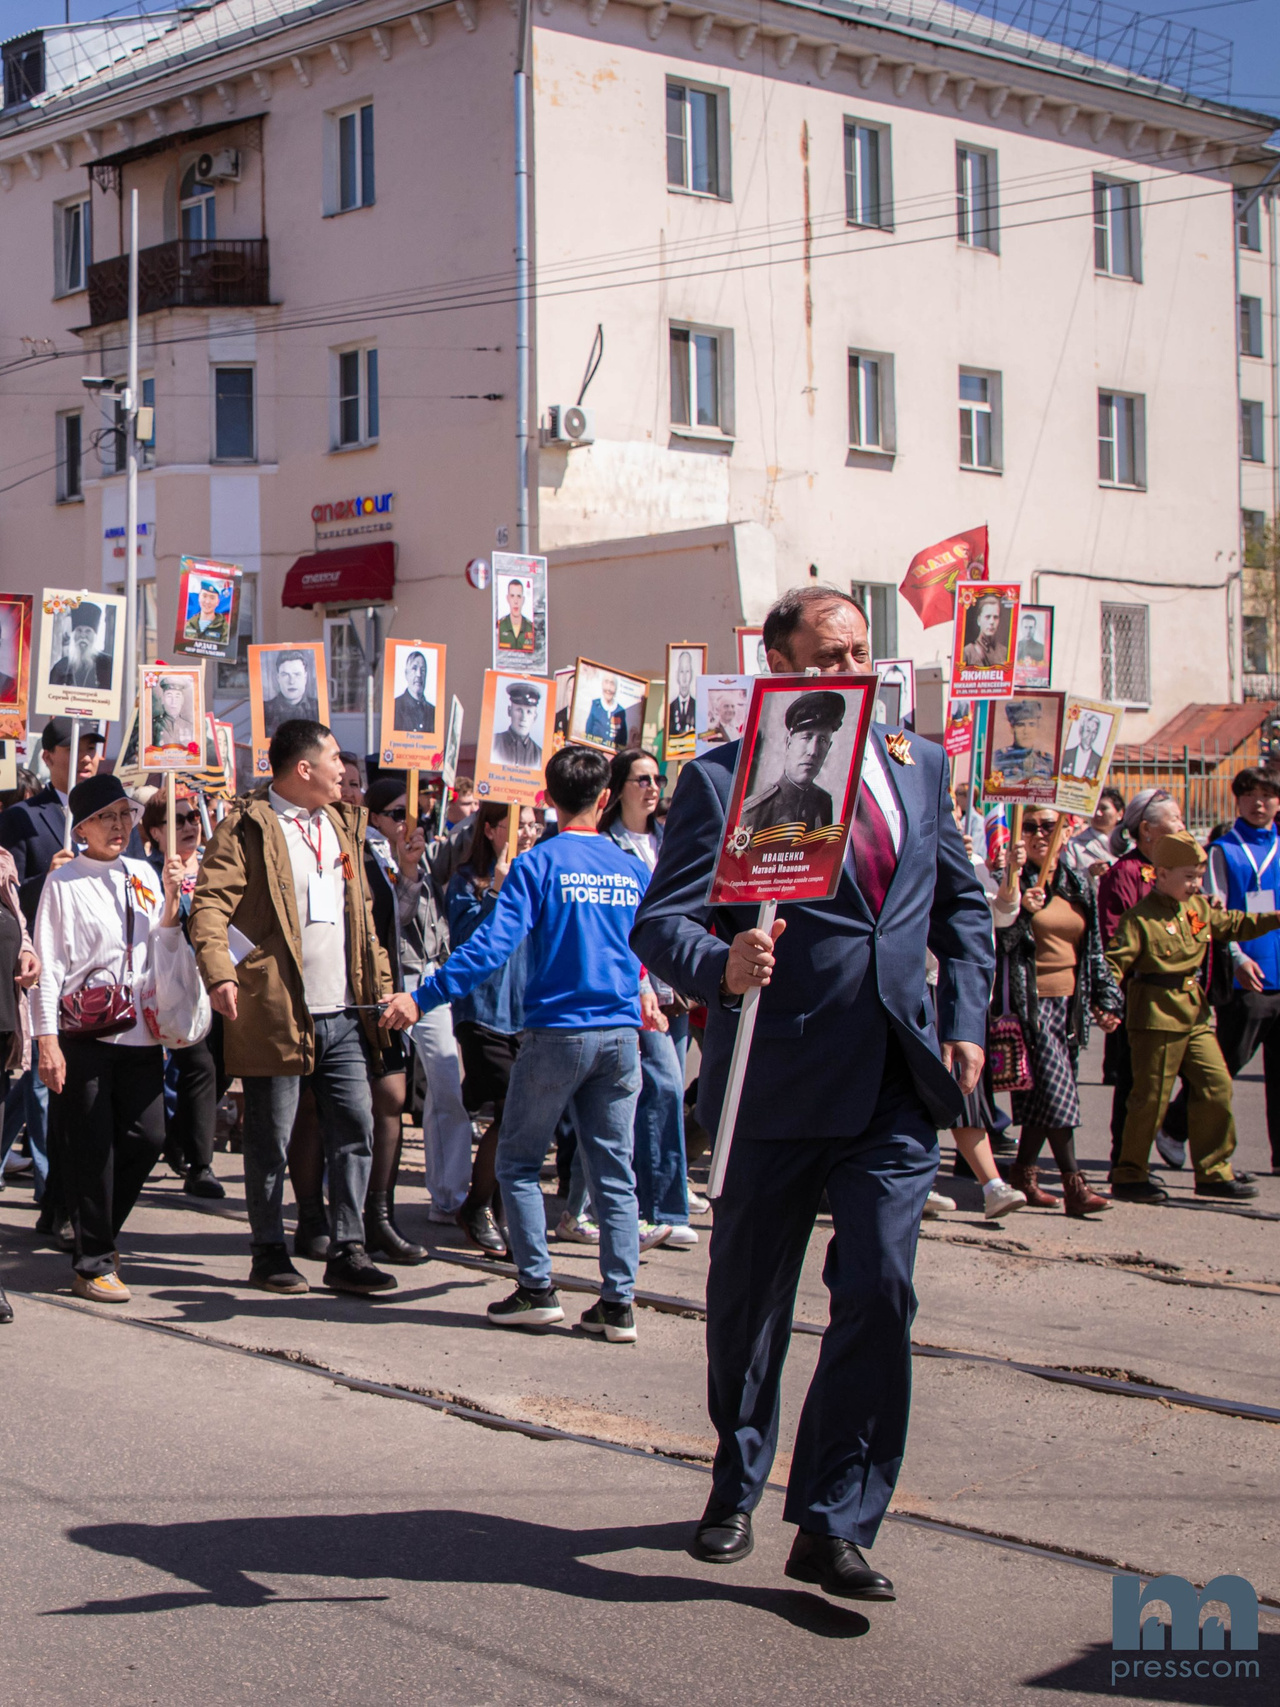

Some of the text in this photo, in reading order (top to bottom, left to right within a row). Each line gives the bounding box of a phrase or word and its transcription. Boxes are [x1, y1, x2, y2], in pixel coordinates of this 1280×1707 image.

[311, 493, 393, 523] anextour
[961, 670, 1004, 681] ЯКИМЕЦ
[761, 851, 805, 863] ИВАЩЕНКО
[751, 864, 810, 875] Матвей Иванович
[560, 872, 639, 889] ВОЛОНТЁРЫ
[562, 886, 639, 907] ПОБЕДЫ
